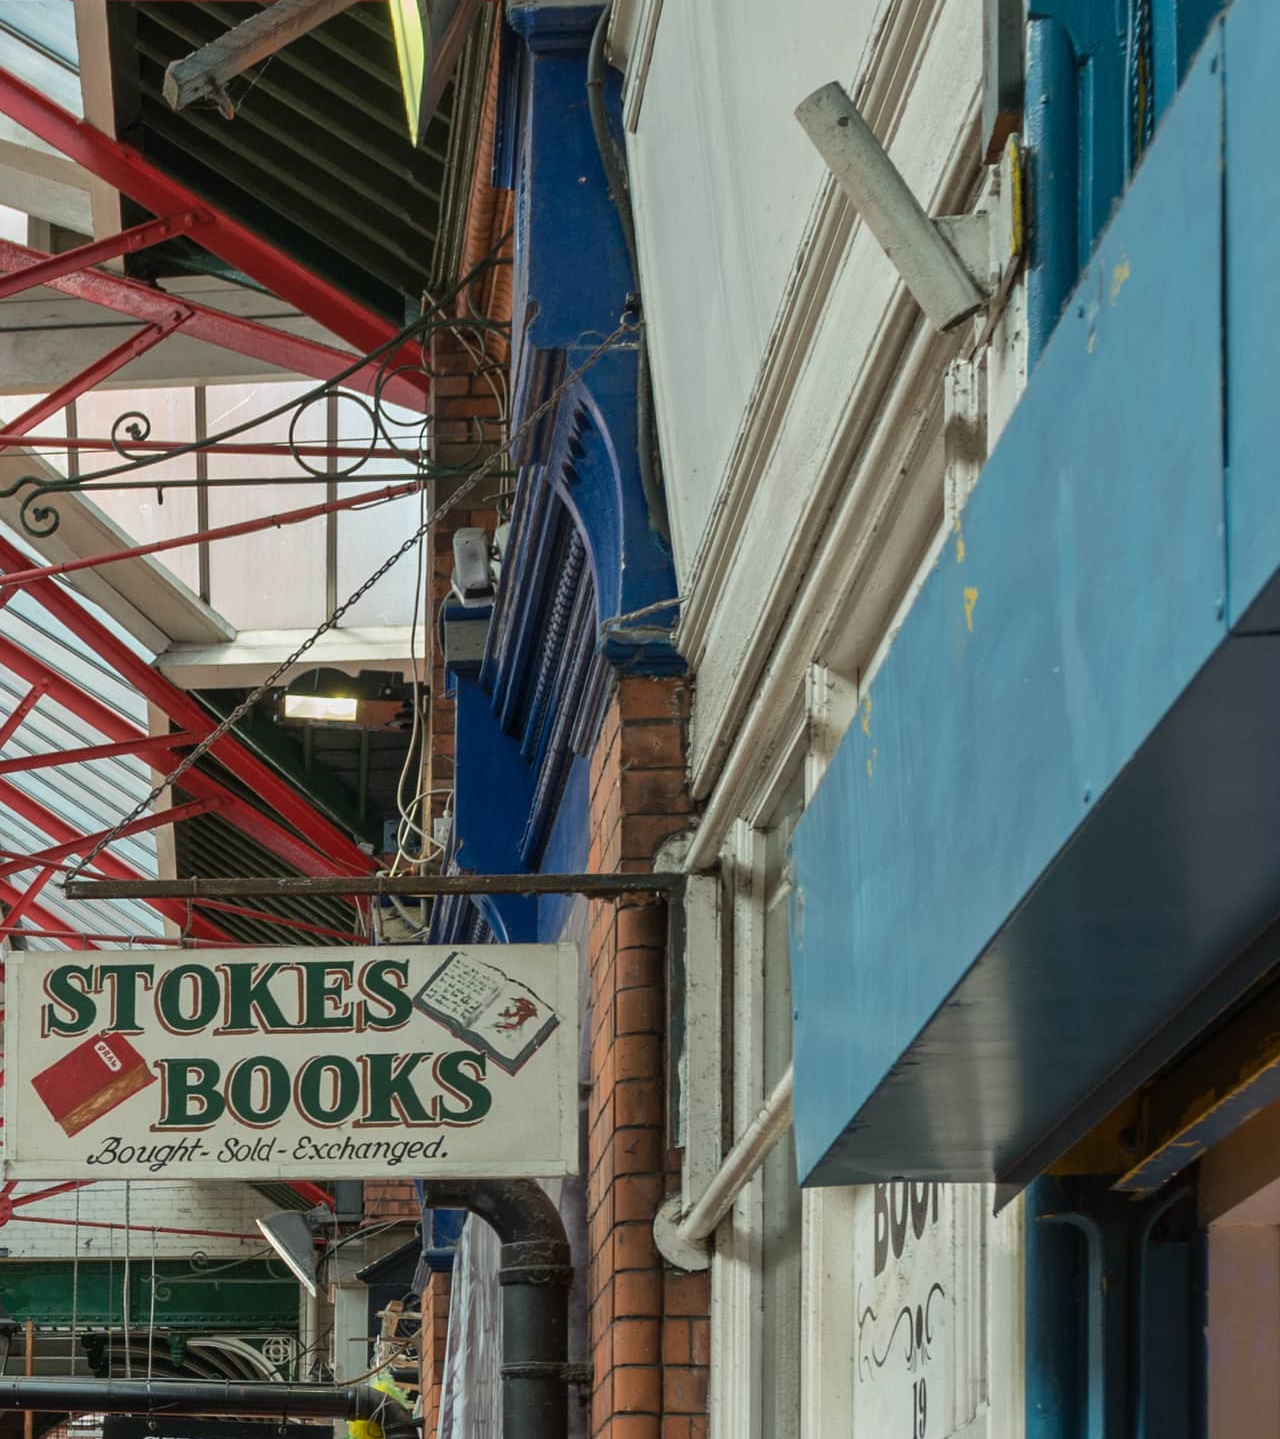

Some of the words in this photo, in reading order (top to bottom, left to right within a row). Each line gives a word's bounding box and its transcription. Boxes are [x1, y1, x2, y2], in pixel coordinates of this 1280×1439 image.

[41, 959, 413, 1038] STOKES
[150, 1050, 493, 1132] BOOKS
[292, 1135, 448, 1166] Exchanged.
